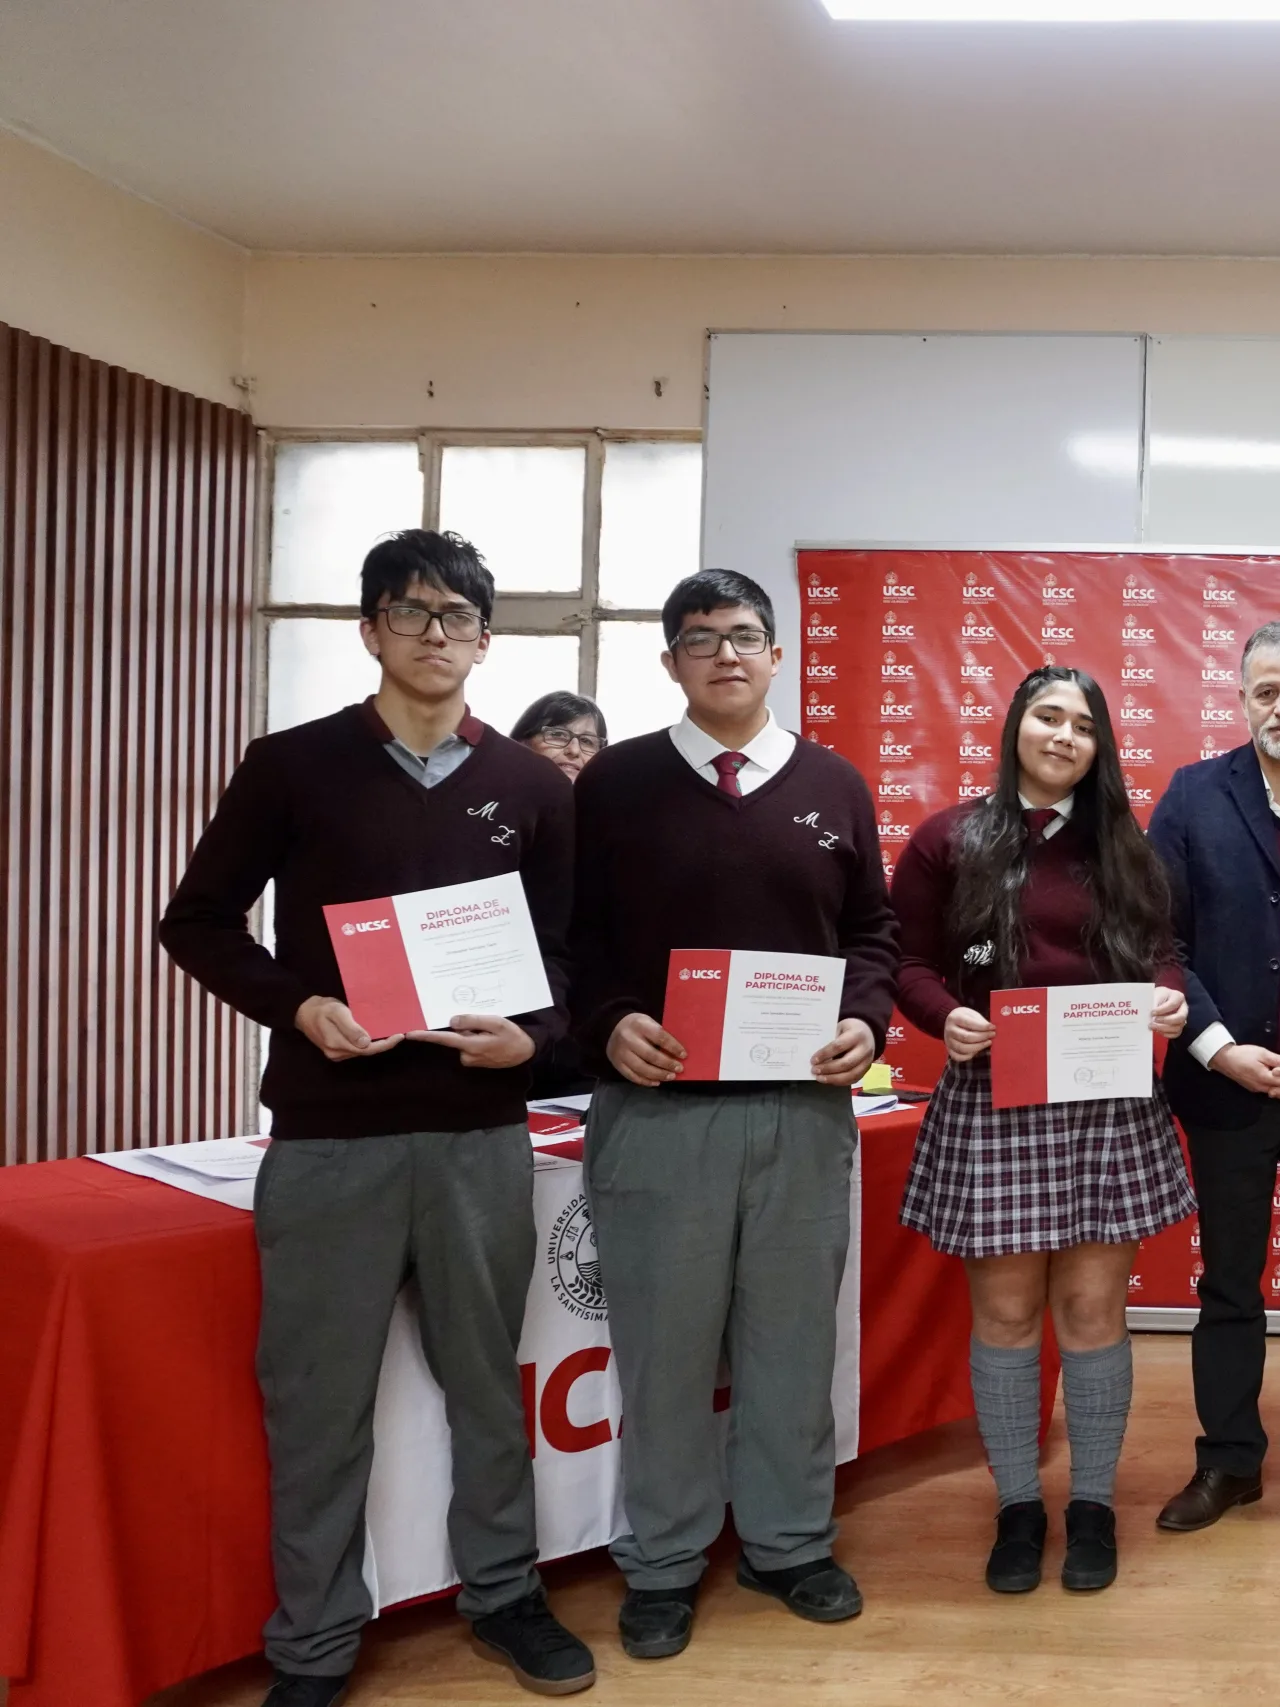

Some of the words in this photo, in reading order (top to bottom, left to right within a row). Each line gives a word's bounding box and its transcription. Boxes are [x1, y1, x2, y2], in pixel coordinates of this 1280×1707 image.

[807, 585, 839, 597] UCSC
[882, 585, 915, 597] UCSC
[962, 586, 995, 598] UCSC
[1042, 587, 1075, 599] UCSC
[1122, 588, 1155, 600] UCSC
[1203, 589, 1236, 601] UCSC
[807, 625, 838, 637] UCSC
[882, 624, 914, 636] UCSC
[961, 625, 995, 637] UCSC
[1041, 627, 1074, 639] UCSC
[1121, 628, 1155, 640] UCSC
[1202, 629, 1235, 641] UCSC
[806, 665, 837, 677] UCSC
[881, 664, 915, 676] UCSC
[960, 665, 994, 677] UCSC
[1121, 668, 1154, 680] UCSC
[1201, 669, 1234, 681] UCSC
[806, 704, 836, 716] UCSC
[880, 704, 913, 716] UCSC
[960, 705, 993, 717] UCSC
[1120, 708, 1153, 720] UCSC
[1201, 709, 1234, 721] UCSC
[879, 744, 912, 756] UCSC
[959, 745, 992, 757] UCSC
[1119, 748, 1153, 760] UCSC
[878, 784, 912, 796] UCSC
[466, 801, 500, 821] M
[793, 811, 820, 828] M
[877, 824, 910, 836] UCSC
[425, 902, 481, 921] DIPLOMA
[483, 898, 500, 910] DE
[419, 906, 511, 932] PARTICIPACIÓN
[355, 918, 391, 934] UCSC
[691, 968, 722, 980] UCSC
[753, 971, 803, 982] DIPLOMA
[805, 974, 820, 984] DE
[745, 980, 826, 993] PARTICIPACIÓN
[1012, 1004, 1041, 1015] UCSC
[1070, 1001, 1117, 1011] DIPLOMA
[1118, 1000, 1132, 1009] DE
[1063, 1008, 1139, 1020] PARTICIPACIÓN
[885, 1026, 905, 1038] SC
[889, 1066, 904, 1078] SC
[547, 1193, 587, 1265] UNIVERSIDA
[550, 1275, 561, 1292] LA
[1128, 1274, 1142, 1287] SC
